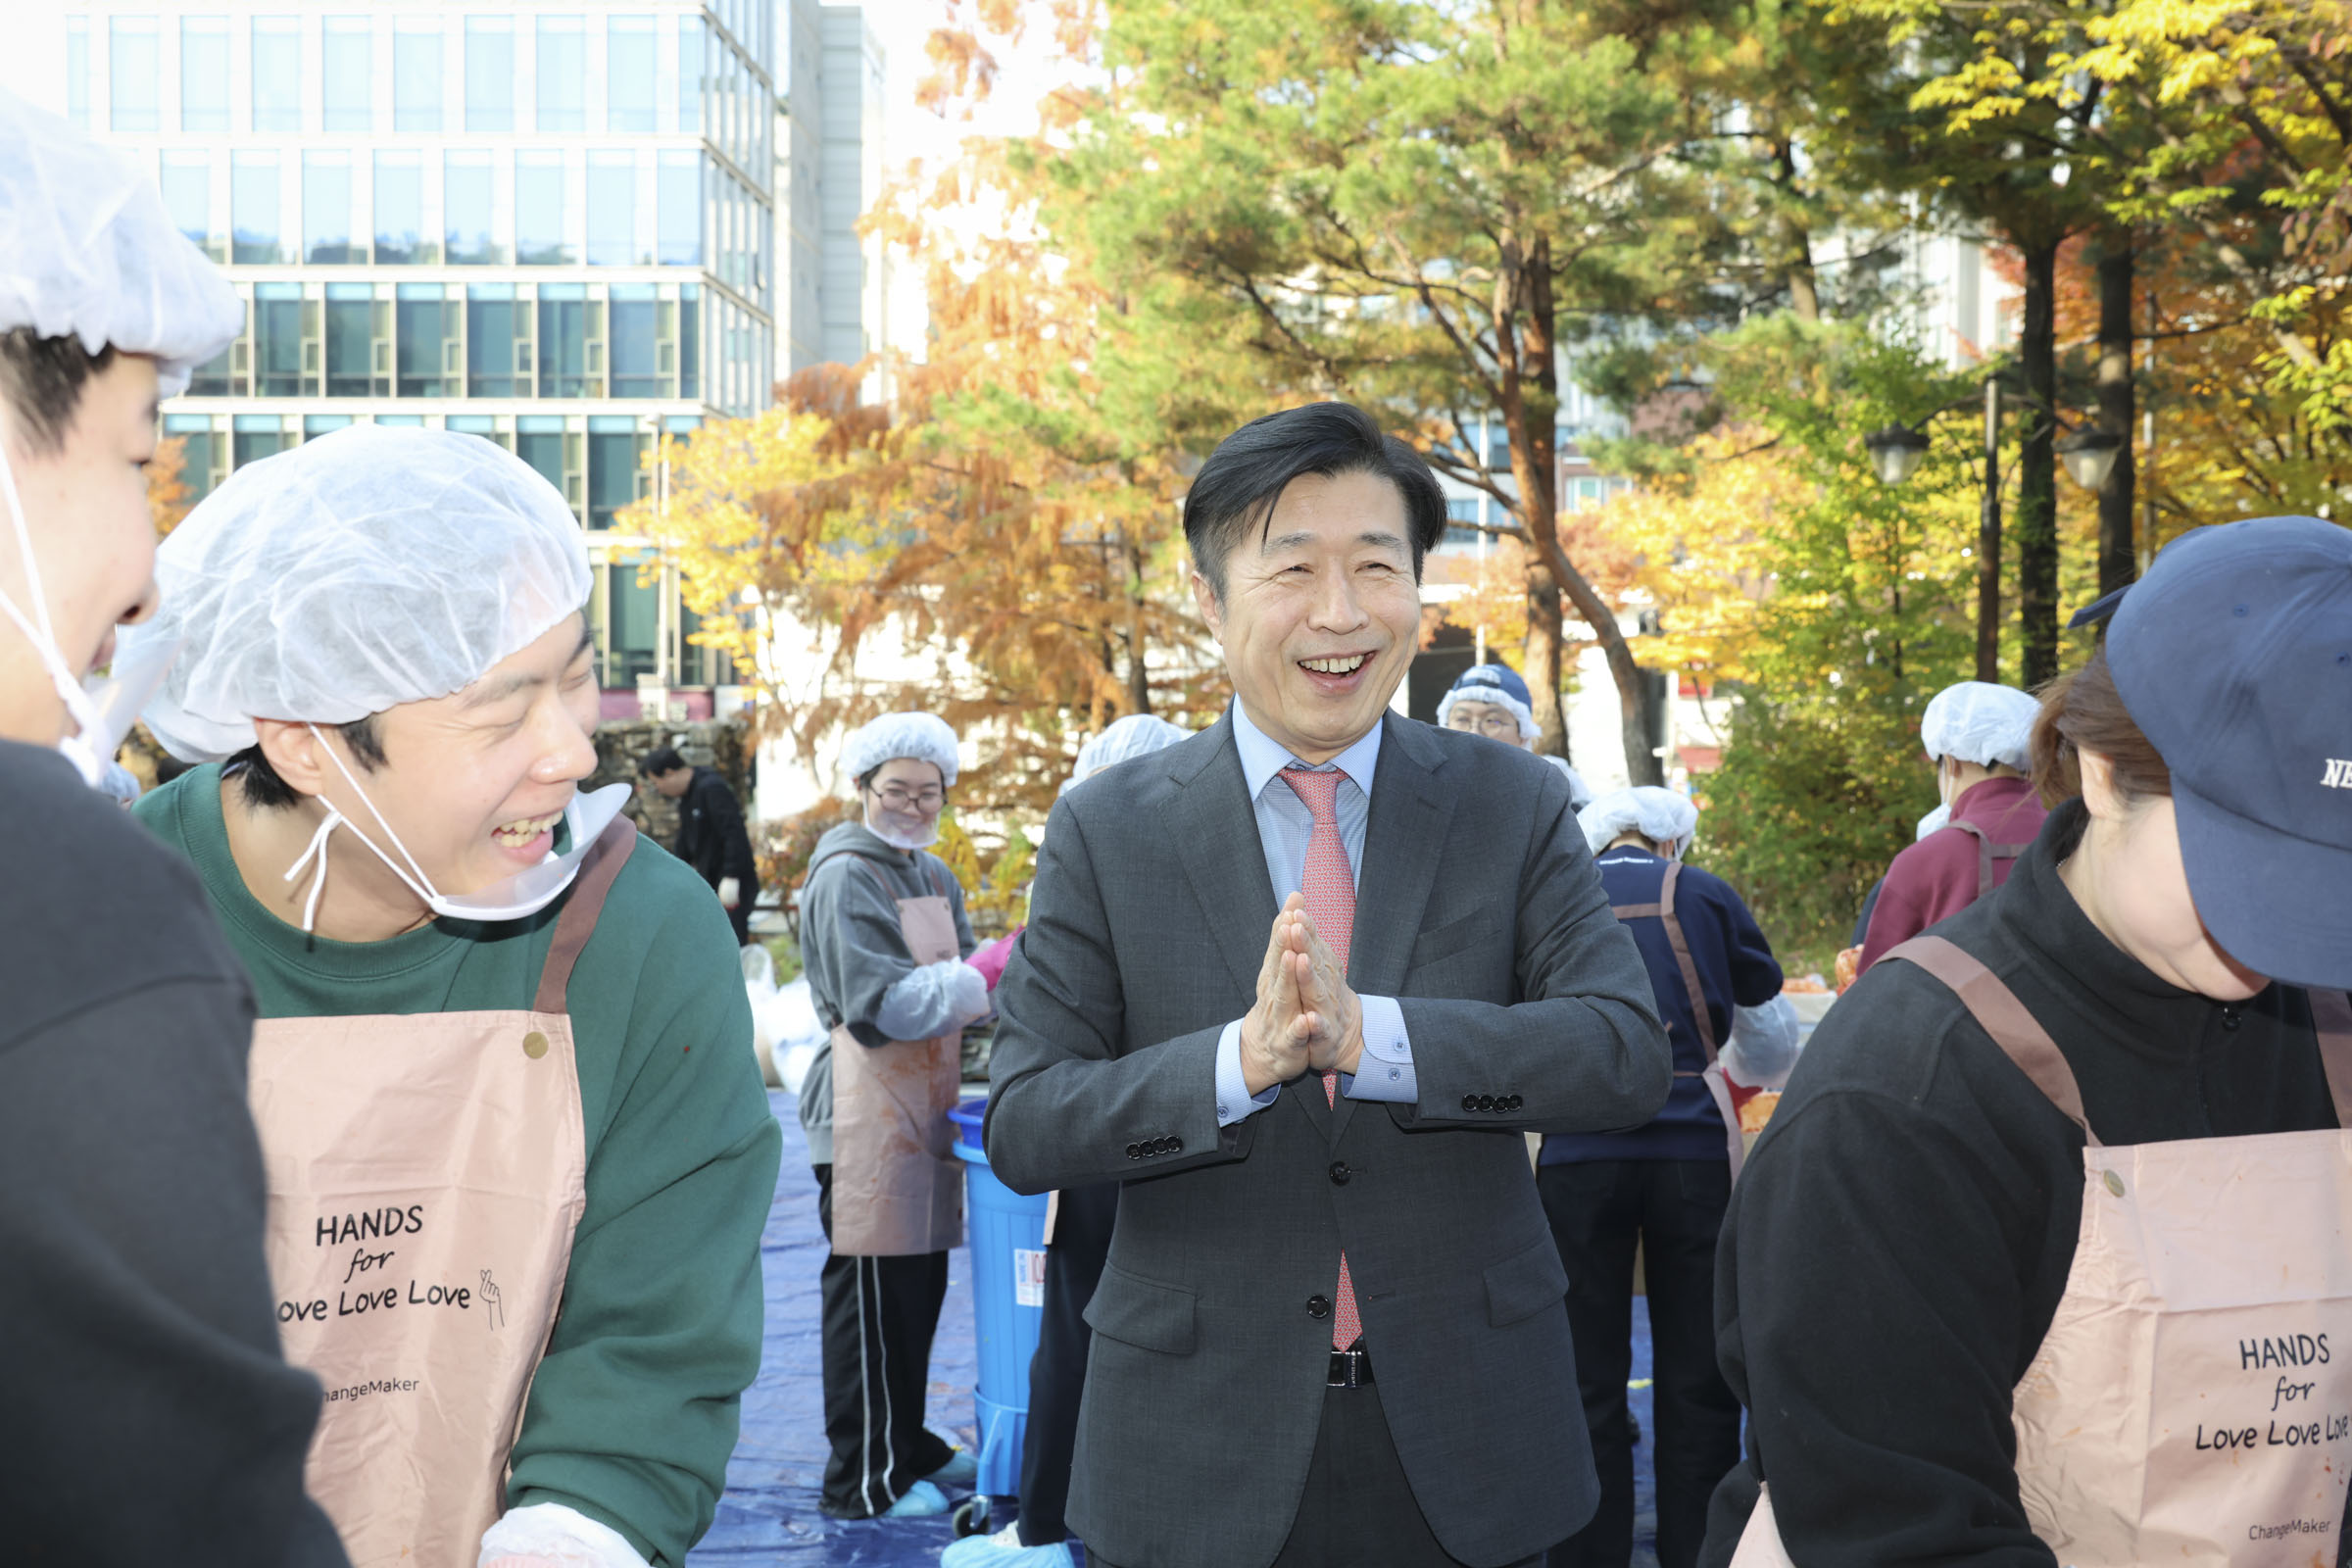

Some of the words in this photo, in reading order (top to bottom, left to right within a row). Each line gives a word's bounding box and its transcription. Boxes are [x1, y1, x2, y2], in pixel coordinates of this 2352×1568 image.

[316, 1205, 423, 1247] HANDS
[343, 1249, 395, 1284] for
[276, 1299, 327, 1323] ove
[338, 1287, 398, 1316] Love
[408, 1279, 470, 1309] Love
[2239, 1333, 2330, 1370] HANDS
[325, 1377, 419, 1402] angeMaker
[2271, 1376, 2316, 1411] for
[2195, 1424, 2258, 1450] Love
[2267, 1420, 2321, 1446] Love
[2327, 1414, 2349, 1442] Love
[2248, 1518, 2331, 1541] ChangeMaker
